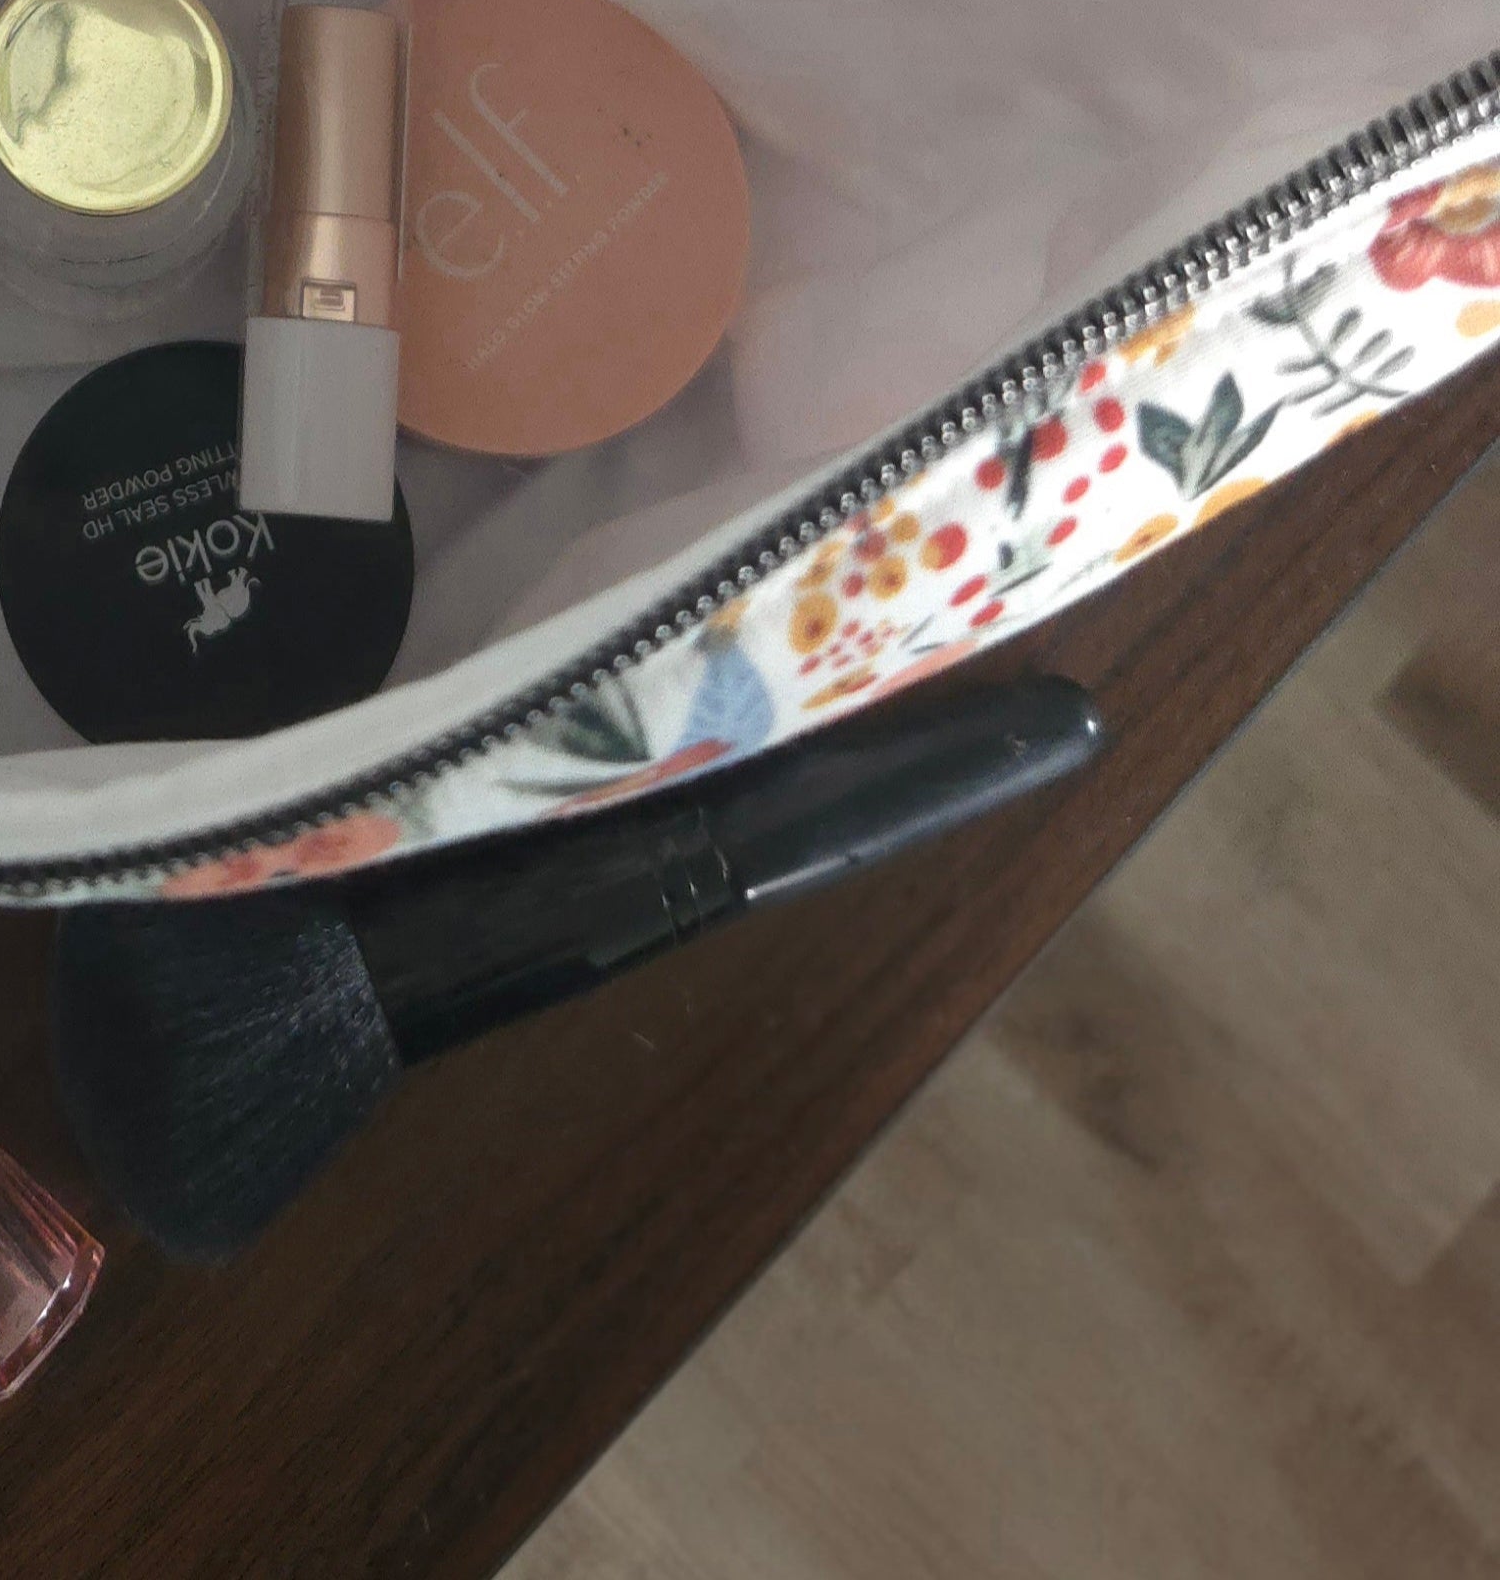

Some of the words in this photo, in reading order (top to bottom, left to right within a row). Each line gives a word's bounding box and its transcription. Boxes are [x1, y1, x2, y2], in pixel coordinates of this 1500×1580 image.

[179, 440, 238, 477] TTING
[82, 463, 173, 512] POWDER
[173, 467, 238, 508] WLESS
[82, 517, 114, 541] HD
[120, 497, 171, 525] SEAL
[135, 513, 275, 583] Kokie
